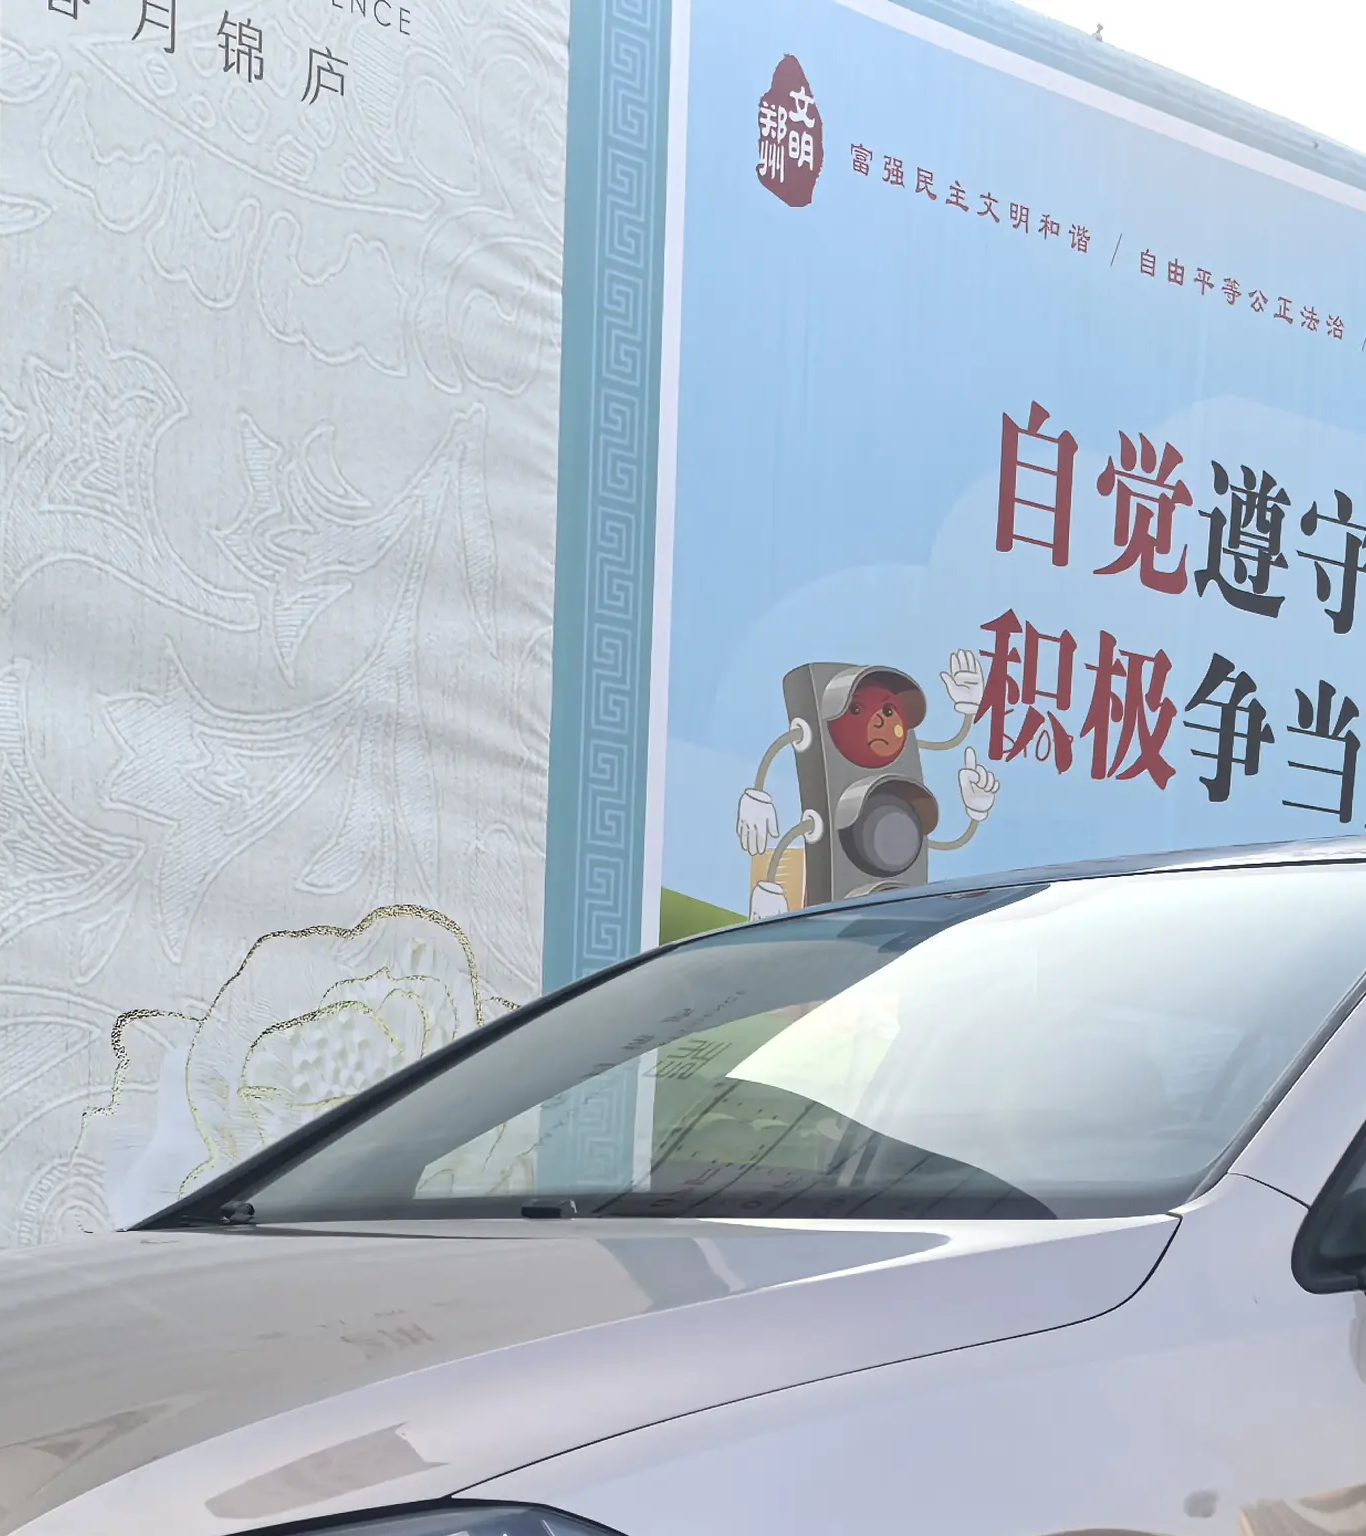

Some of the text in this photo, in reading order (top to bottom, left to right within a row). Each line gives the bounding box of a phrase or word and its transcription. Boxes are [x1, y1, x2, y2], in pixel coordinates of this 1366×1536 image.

[332, 0, 411, 36] NCE
[849, 143, 1092, 255] 富强民主文明和谐
[1138, 248, 1345, 341] 自由平等公正法治
